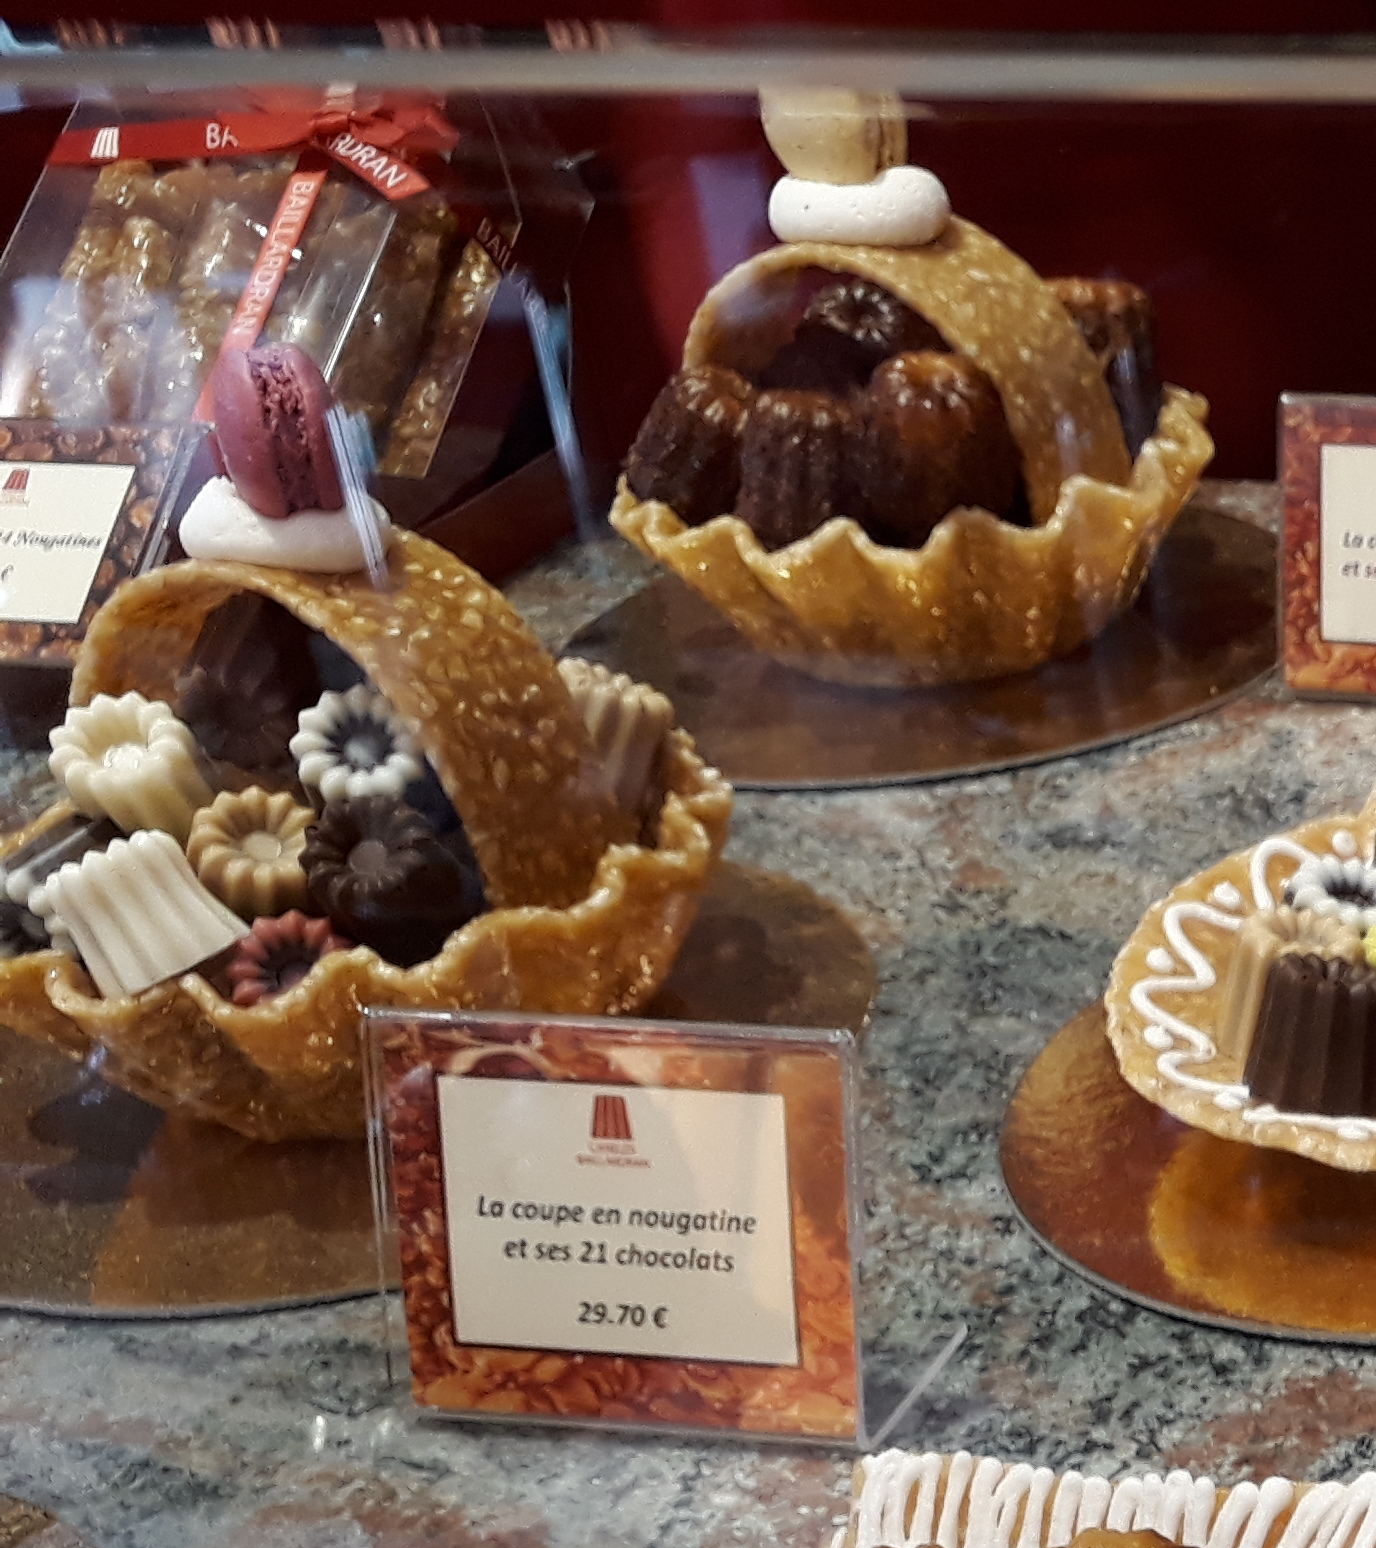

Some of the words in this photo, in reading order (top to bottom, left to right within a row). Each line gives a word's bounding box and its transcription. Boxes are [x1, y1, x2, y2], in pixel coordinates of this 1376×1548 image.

[477, 1195, 505, 1219] La
[511, 1202, 585, 1226] coupe
[591, 1207, 622, 1225] en
[627, 1208, 757, 1237] nougatine
[503, 1238, 528, 1260] et
[534, 1242, 572, 1262] ses
[579, 1240, 607, 1265] 21
[614, 1242, 735, 1273] chocolats
[577, 1301, 647, 1328] 29.70
[652, 1306, 668, 1330] €
